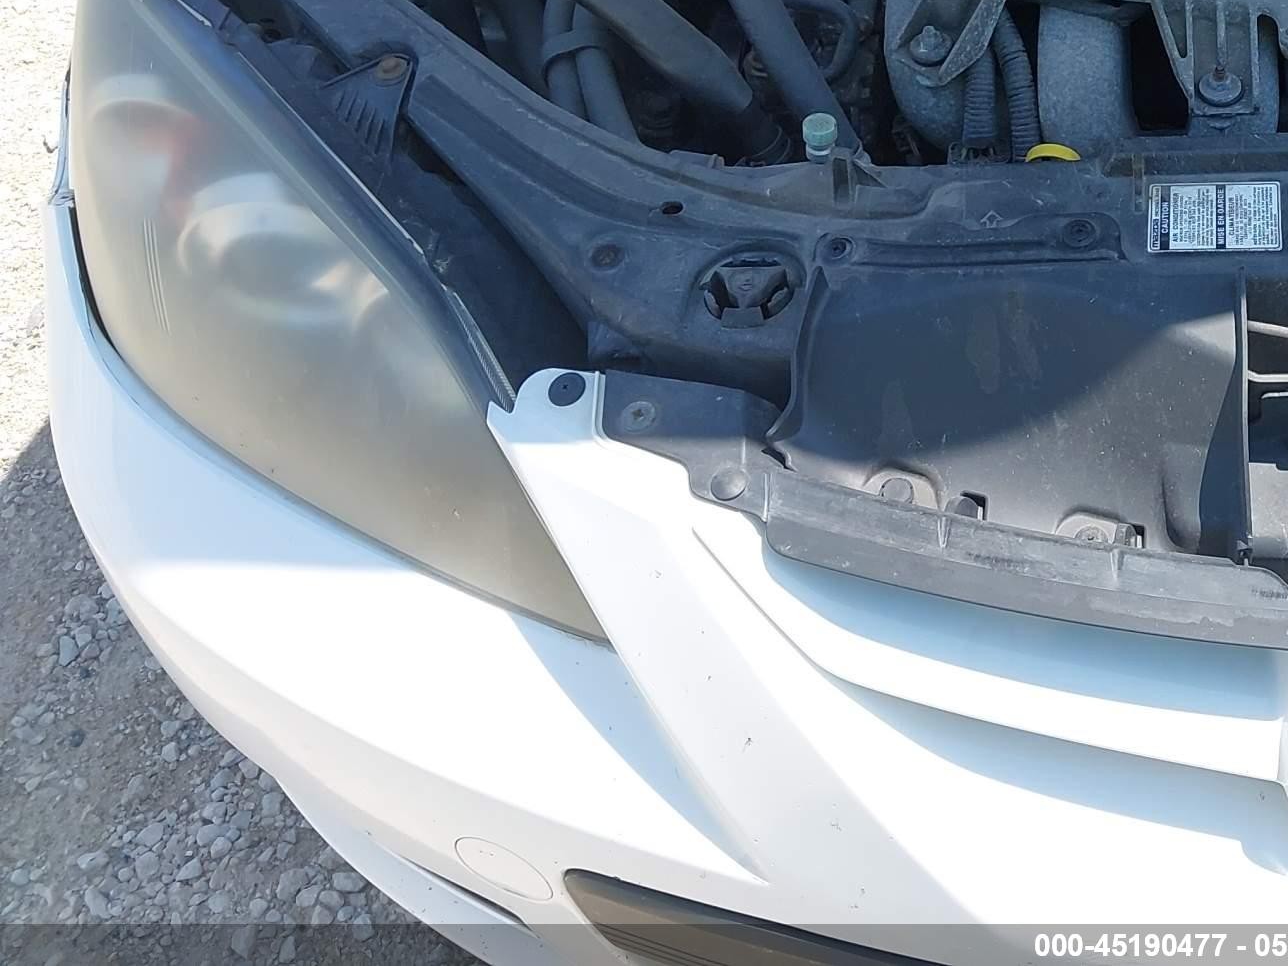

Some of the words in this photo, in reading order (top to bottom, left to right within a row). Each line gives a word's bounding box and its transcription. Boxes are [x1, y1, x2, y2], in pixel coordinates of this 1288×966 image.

[1161, 201, 1169, 234] CAUTION
[1217, 215, 1225, 226] EN
[1152, 218, 1160, 248] mazda
[1217, 227, 1225, 244] MISE
